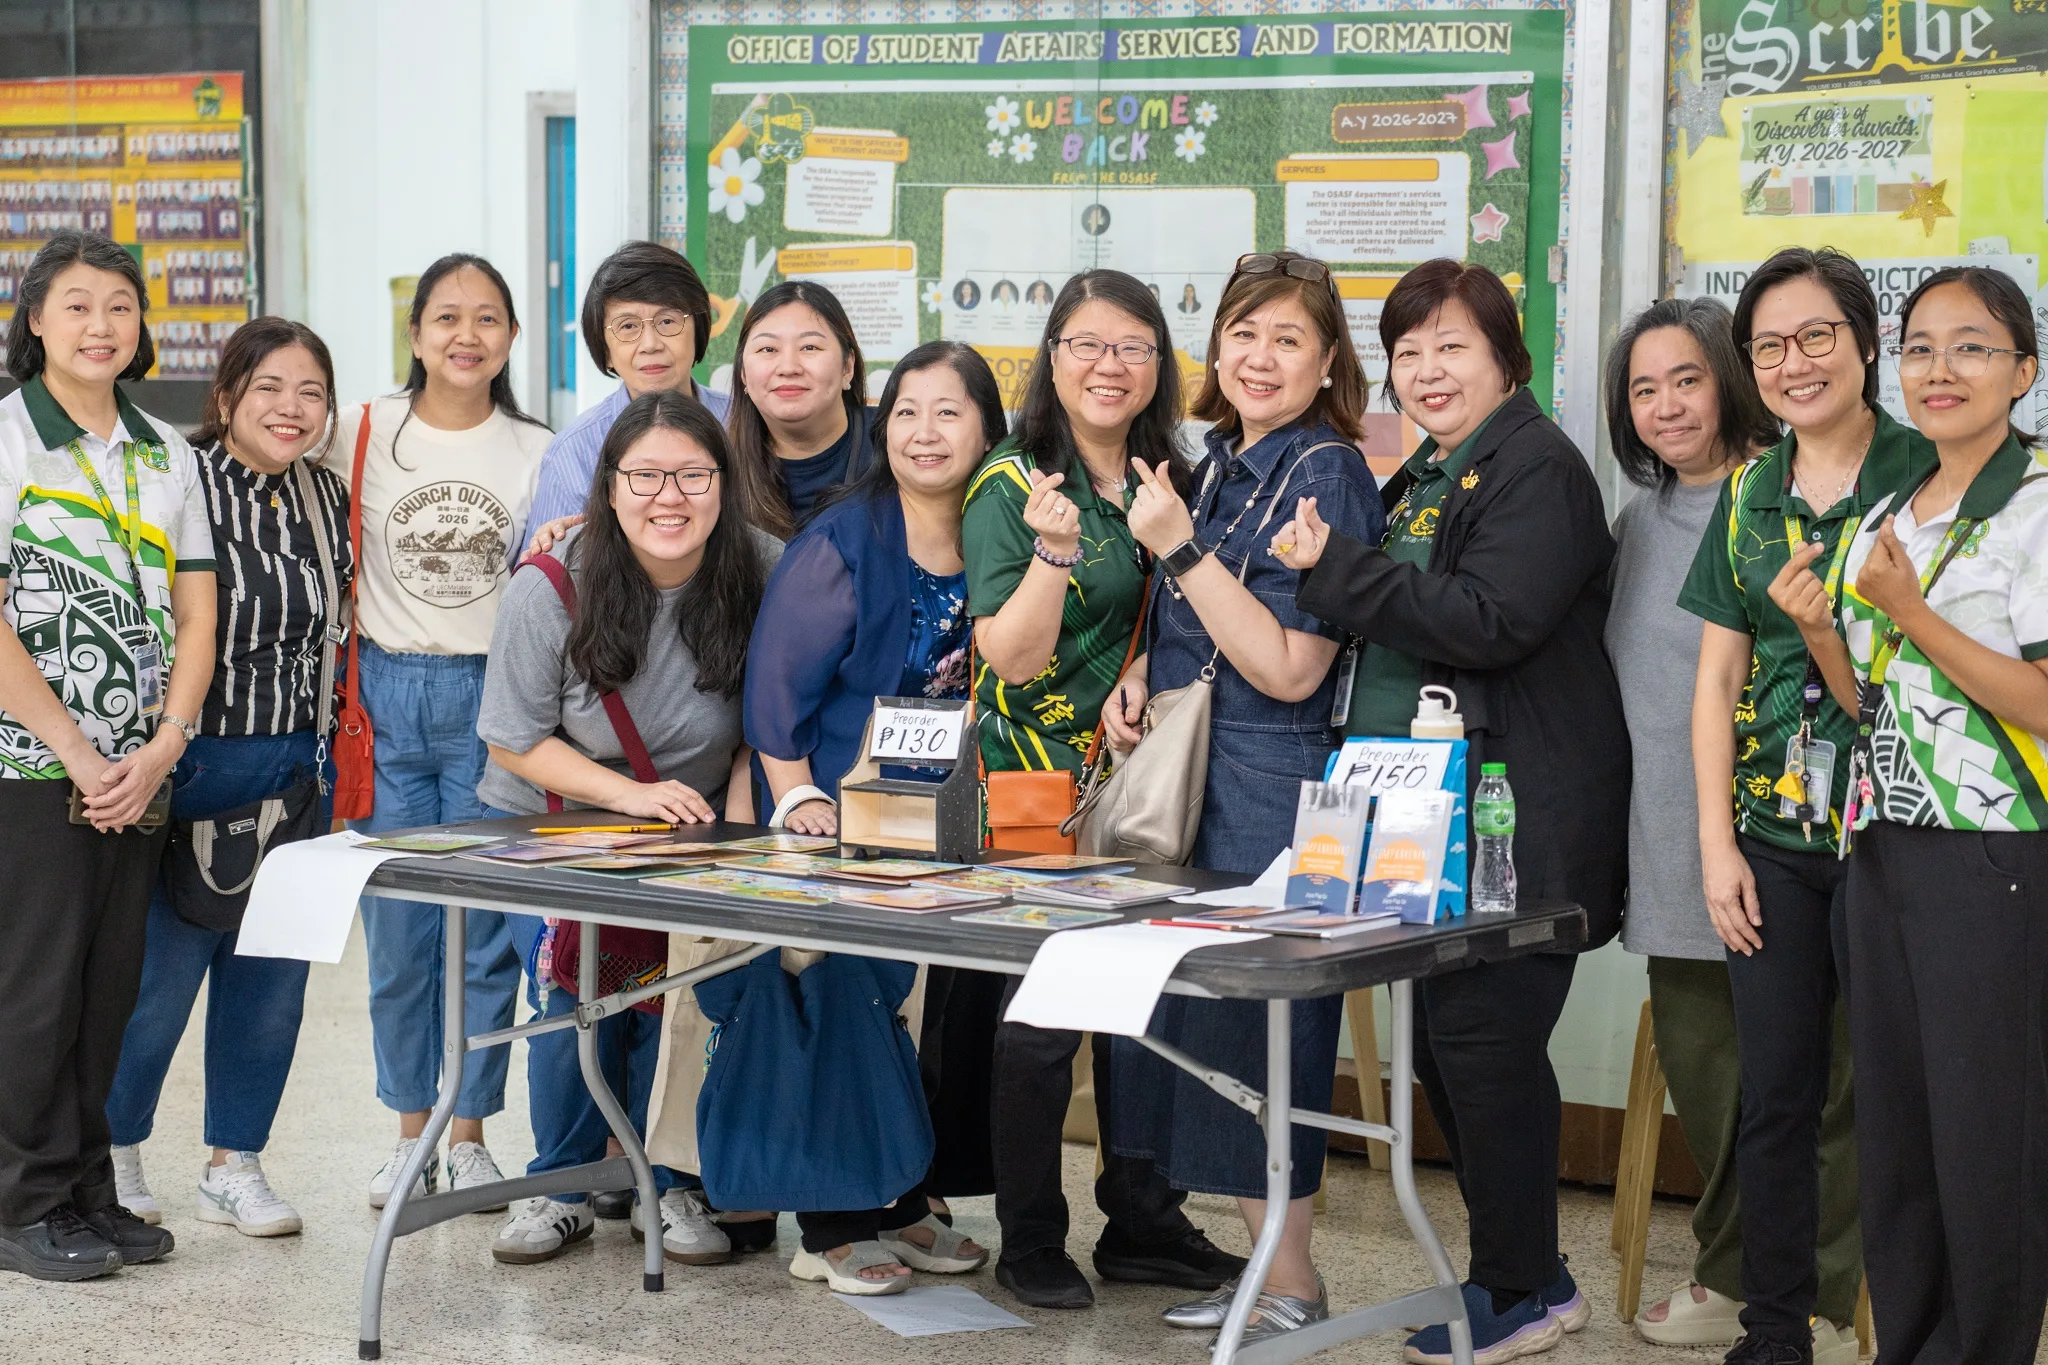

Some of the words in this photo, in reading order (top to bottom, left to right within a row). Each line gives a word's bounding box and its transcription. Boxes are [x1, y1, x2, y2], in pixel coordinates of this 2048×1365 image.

[728, 36, 813, 62] OFFICE
[824, 36, 859, 63] OF
[868, 35, 981, 61] STUDENT
[1000, 33, 1103, 60] AFFAIRS
[1118, 30, 1239, 58] SERVICES
[1253, 26, 1318, 53] AND
[1337, 24, 1511, 53] FORMATION
[1998, 66, 2025, 74] Caloocan
[2025, 64, 2039, 72] City
[1025, 95, 1190, 129] WELCOME
[1794, 105, 1811, 122] A
[1853, 104, 1870, 125] of
[1340, 116, 1368, 130] A.Y
[1371, 111, 1458, 127] 2026-2027
[1851, 114, 1920, 138] awaits.
[1062, 131, 1150, 166] BACK
[1754, 143, 1797, 167] A.Y.
[1282, 166, 1326, 174] SERVICES
[1092, 171, 1115, 183] THE
[1118, 171, 1159, 184] OSASF
[1312, 190, 1326, 198] The
[1327, 190, 1352, 198] OSASF
[1354, 190, 1407, 200] department's
[1339, 200, 1387, 209] responsible
[1399, 200, 1428, 209] making
[1320, 209, 1336, 217] that
[1337, 209, 1347, 217] all
[1348, 209, 1392, 217] individuals
[1393, 209, 1418, 217] within
[1420, 209, 1432, 217] the
[1338, 219, 1373, 228] premises
[1356, 237, 1379, 245] others
[1397, 237, 1435, 245] delivered
[782, 260, 827, 268] FORMATION
[392, 486, 452, 526] CHURCH
[457, 487, 510, 530] OUTING
[437, 513, 469, 525] 2026
[891, 711, 938, 727] Preorder
[1358, 746, 1431, 764] Preorder
